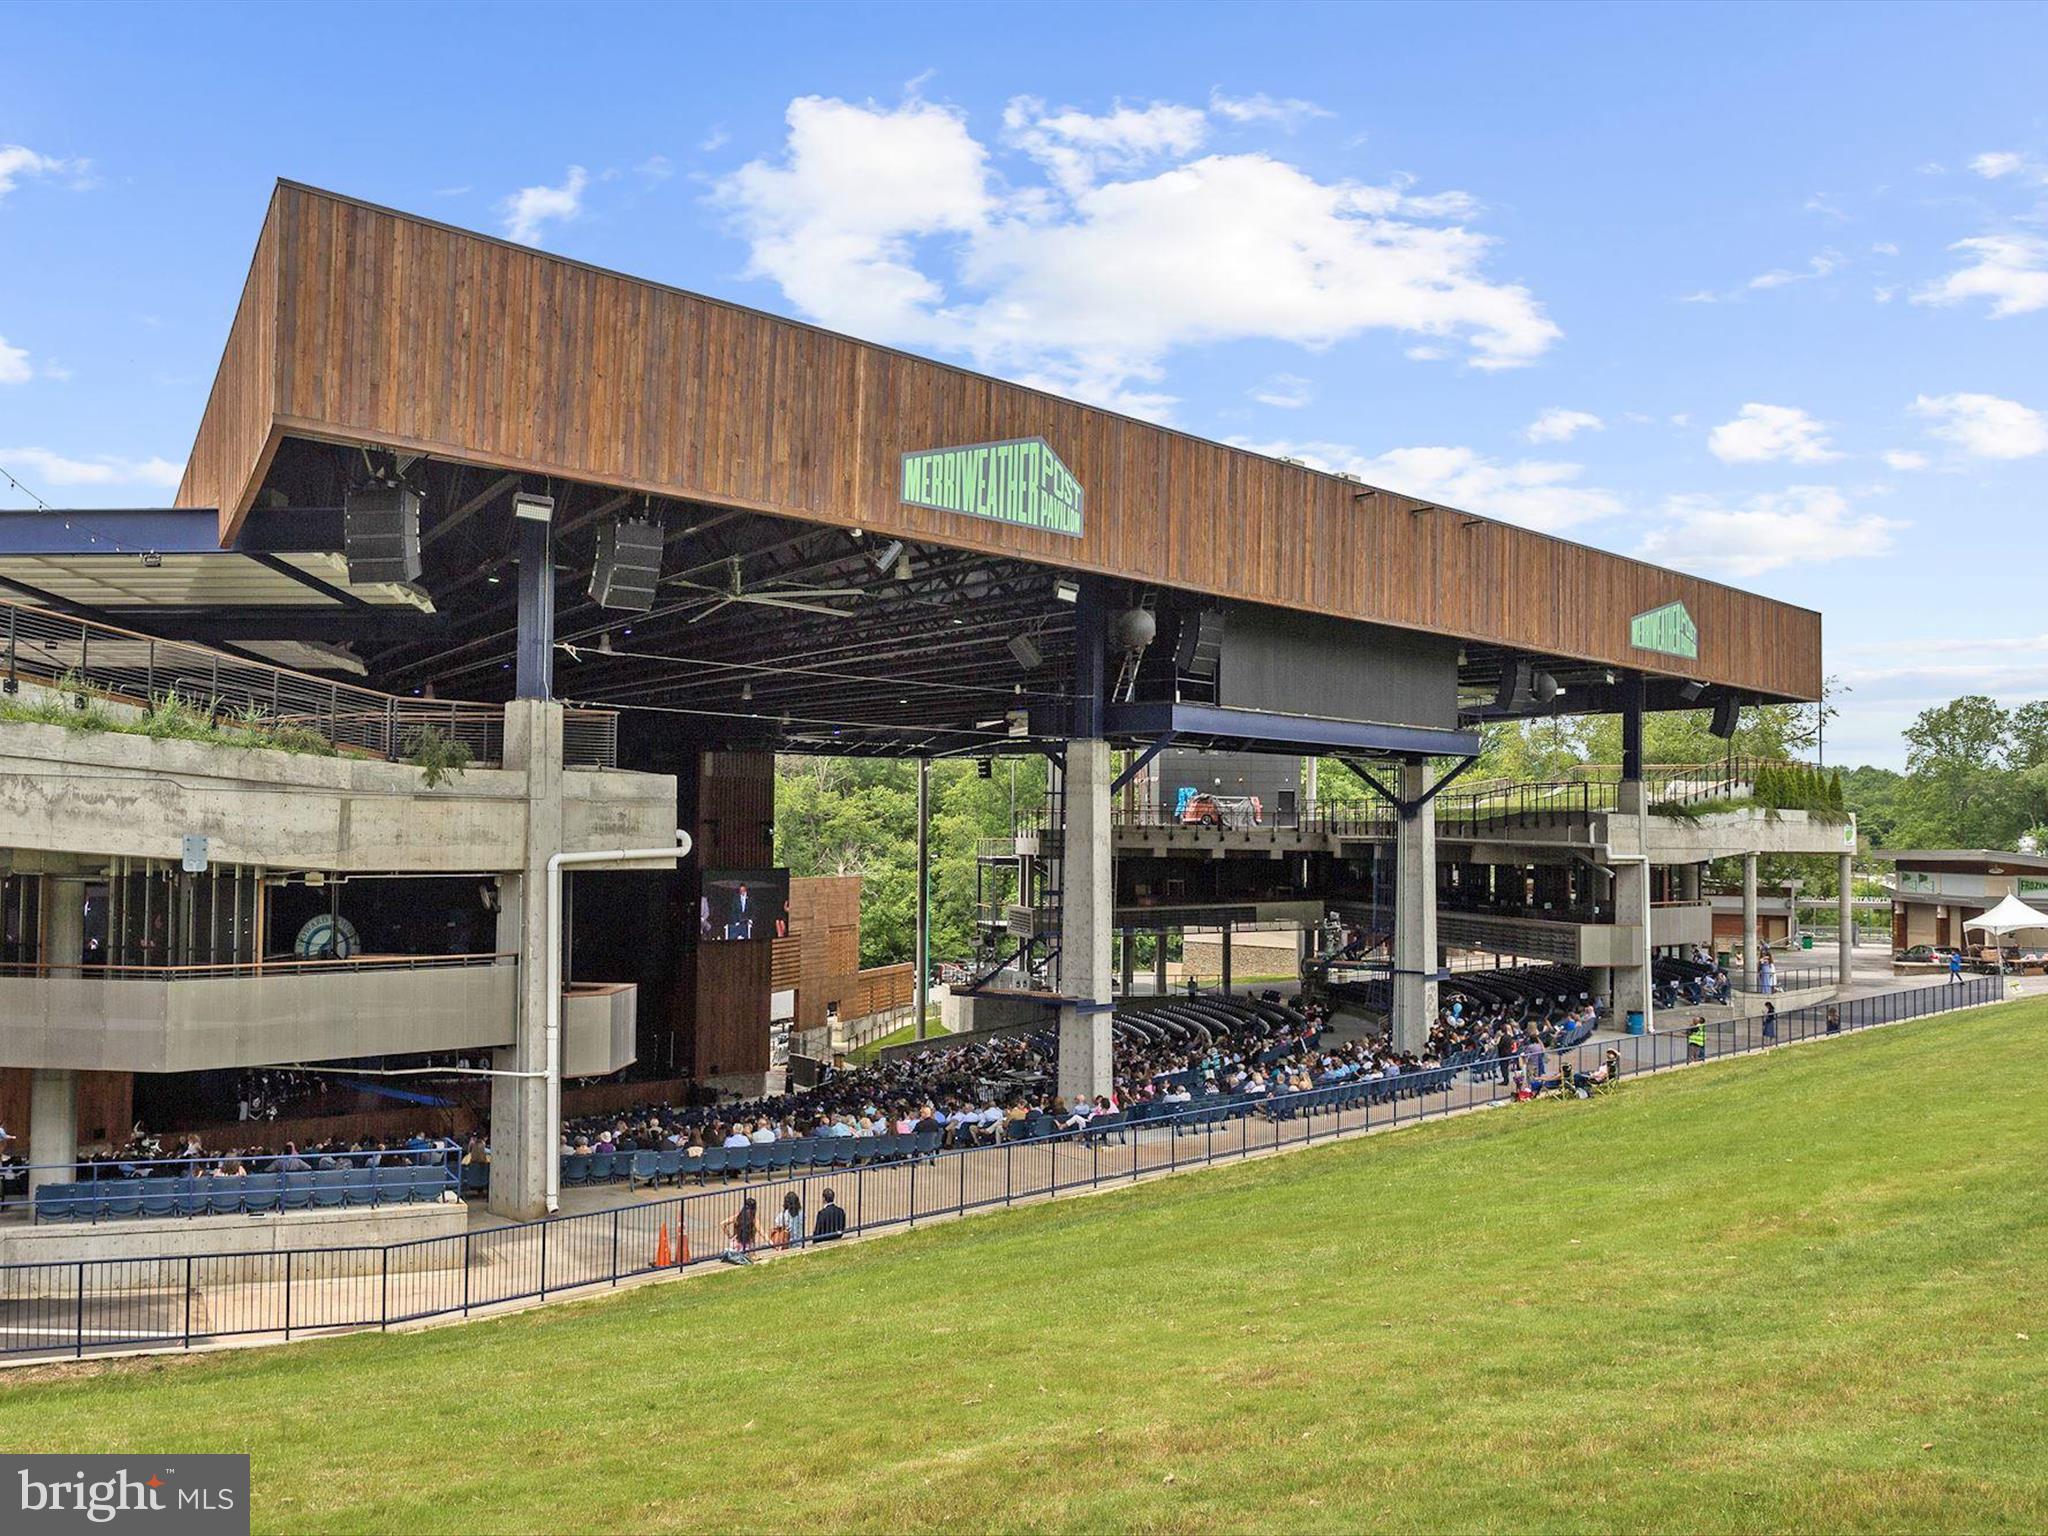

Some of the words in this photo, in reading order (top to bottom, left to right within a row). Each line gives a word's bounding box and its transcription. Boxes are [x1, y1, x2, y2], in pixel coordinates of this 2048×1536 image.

[904, 442, 1040, 525] MERRIWEATHER
[1041, 444, 1082, 511] POST
[1041, 489, 1080, 534] PAVILION
